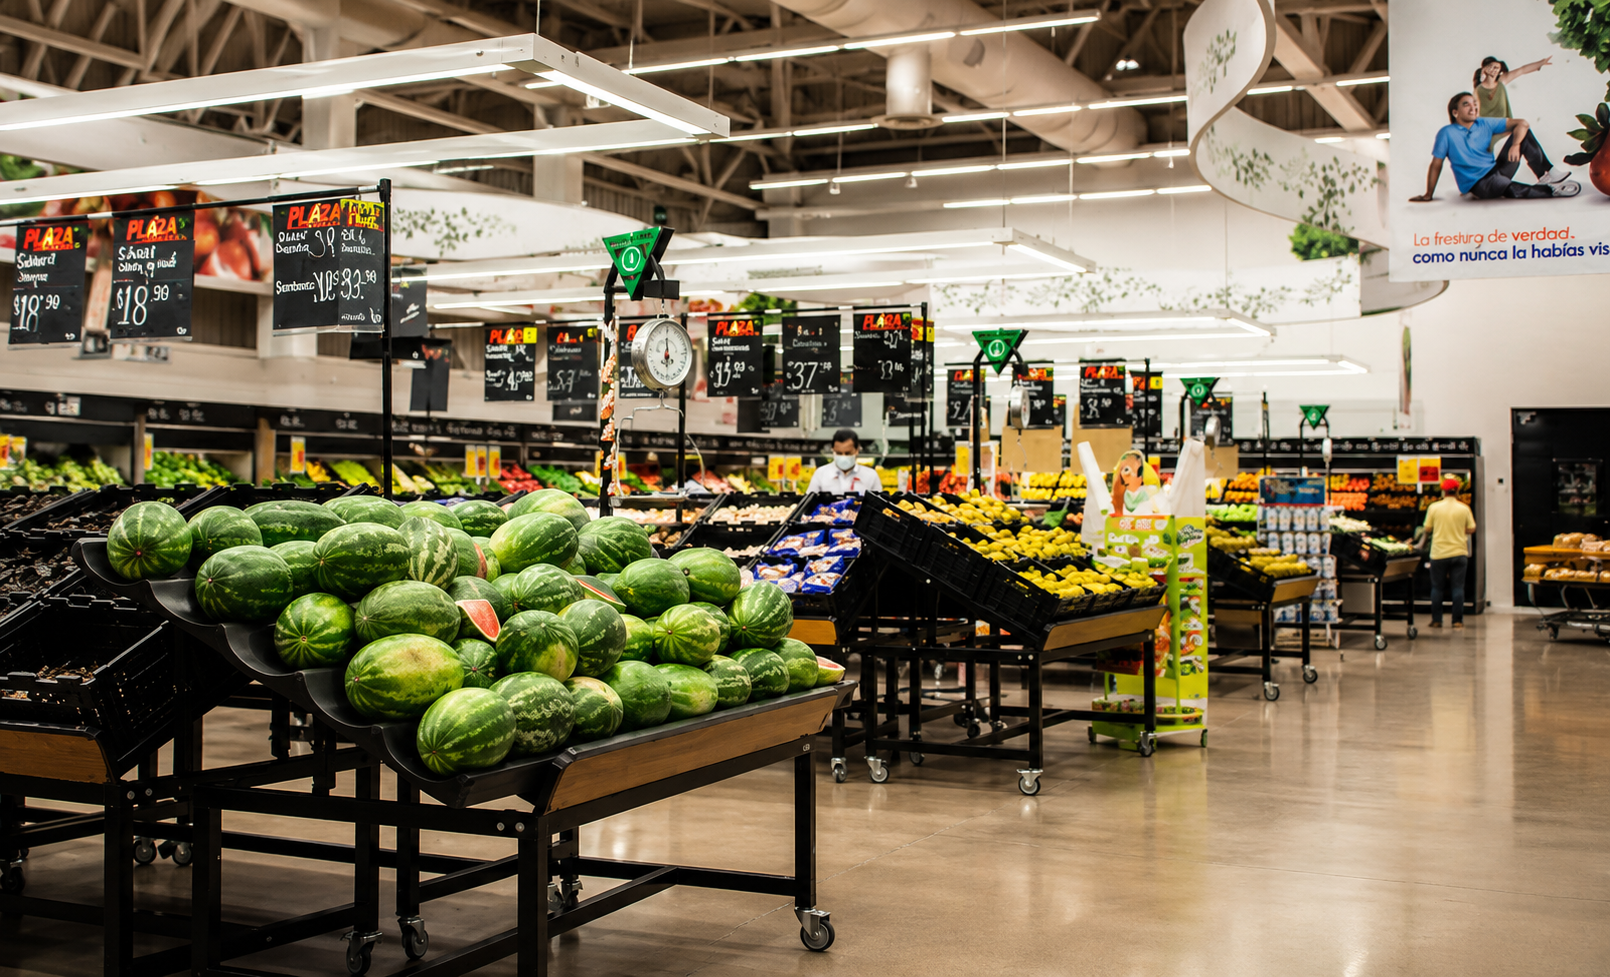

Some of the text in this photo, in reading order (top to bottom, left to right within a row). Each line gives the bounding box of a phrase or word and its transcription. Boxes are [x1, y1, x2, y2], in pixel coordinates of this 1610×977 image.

[1414, 233, 1430, 247] La
[1487, 228, 1508, 243] de
[1412, 252, 1455, 264] como
[1459, 249, 1508, 262] nunca
[1512, 244, 1527, 260] la
[1531, 242, 1585, 258] habías
